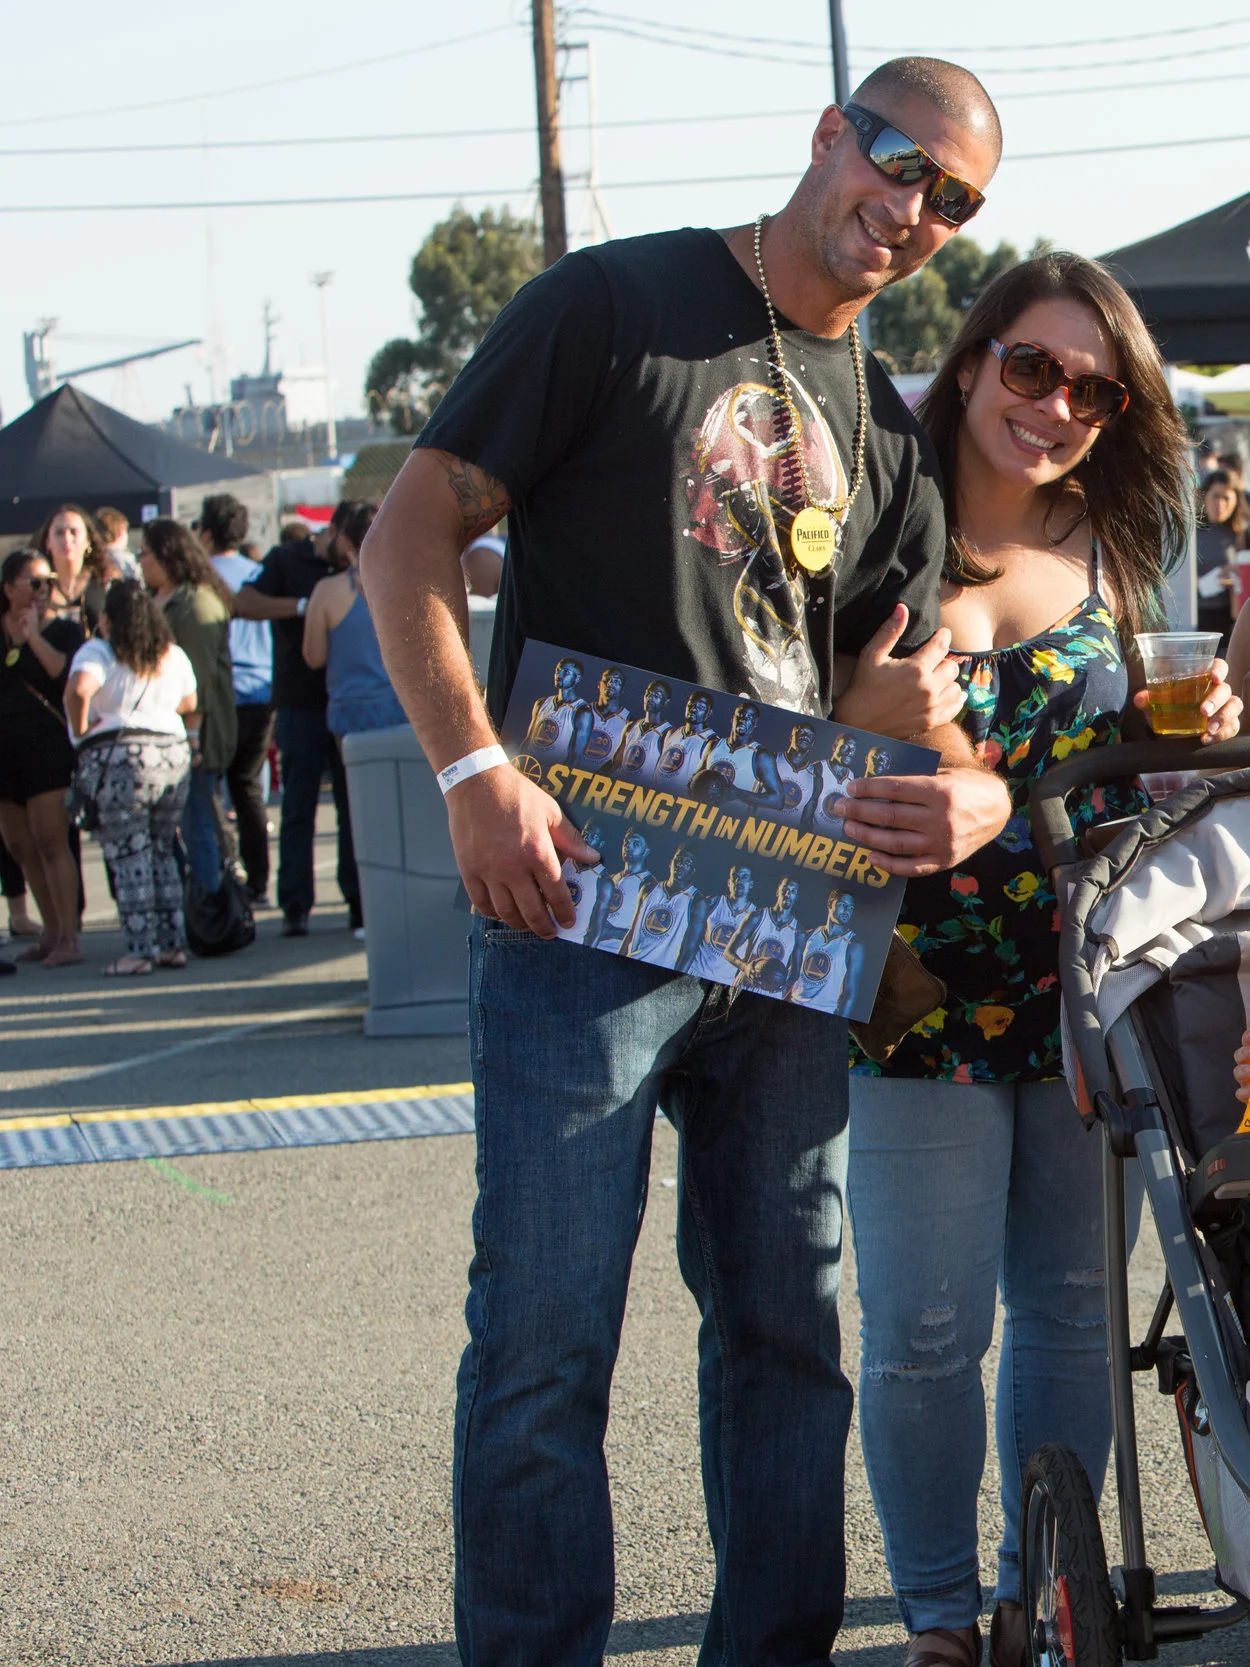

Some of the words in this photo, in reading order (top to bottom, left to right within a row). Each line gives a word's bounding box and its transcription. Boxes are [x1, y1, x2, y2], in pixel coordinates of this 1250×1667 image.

[796, 528, 829, 542] PACIFICO
[595, 736, 609, 746] 20
[720, 767, 732, 777] 23
[788, 787, 796, 796] 3
[541, 762, 719, 840] STRENGTH
[713, 815, 741, 841] IN
[735, 816, 890, 889] NUMBERS
